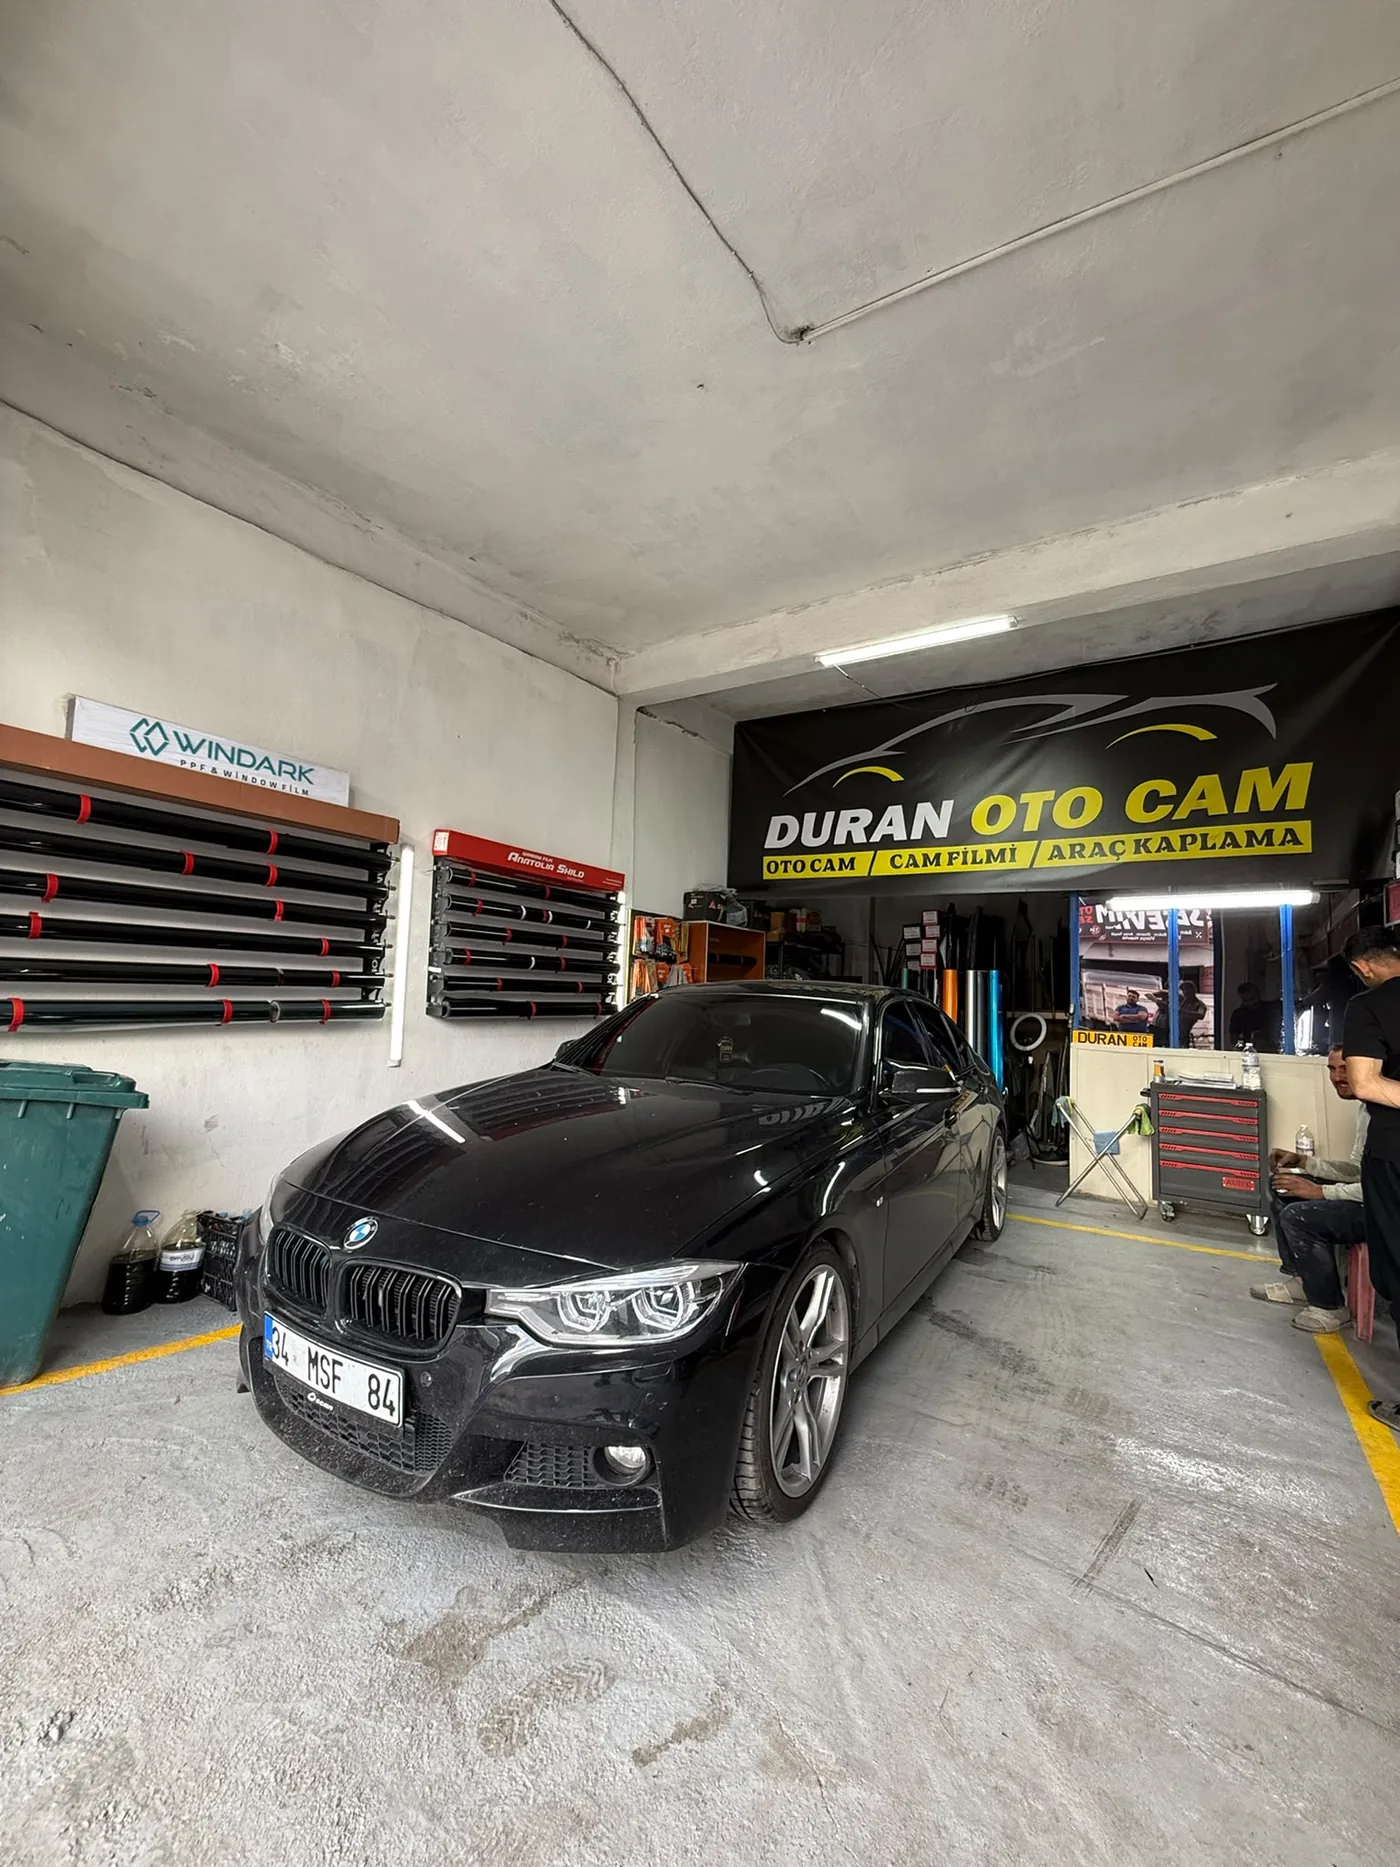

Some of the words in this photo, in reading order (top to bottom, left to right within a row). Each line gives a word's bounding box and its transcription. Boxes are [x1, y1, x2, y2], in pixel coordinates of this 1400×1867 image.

[172, 730, 314, 785] WINDARK
[180, 759, 206, 772] PPF
[210, 767, 218, 775] &
[223, 769, 278, 788] WİNDOW
[282, 783, 309, 796] FİLM
[763, 799, 954, 849] DURAN
[971, 786, 1103, 836] OTO
[1125, 762, 1313, 824] CAM
[889, 851, 941, 869] CAM
[947, 844, 1018, 866] FİLMİ
[1047, 839, 1126, 861] ARAÇ
[1132, 827, 1304, 855] KAPLAMA
[766, 859, 806, 874] OTO
[810, 856, 855, 872] CAM
[1077, 1031, 1127, 1046] DURAN
[272, 1326, 289, 1367] 34
[307, 1346, 343, 1394] MSF
[368, 1373, 396, 1417] 84
